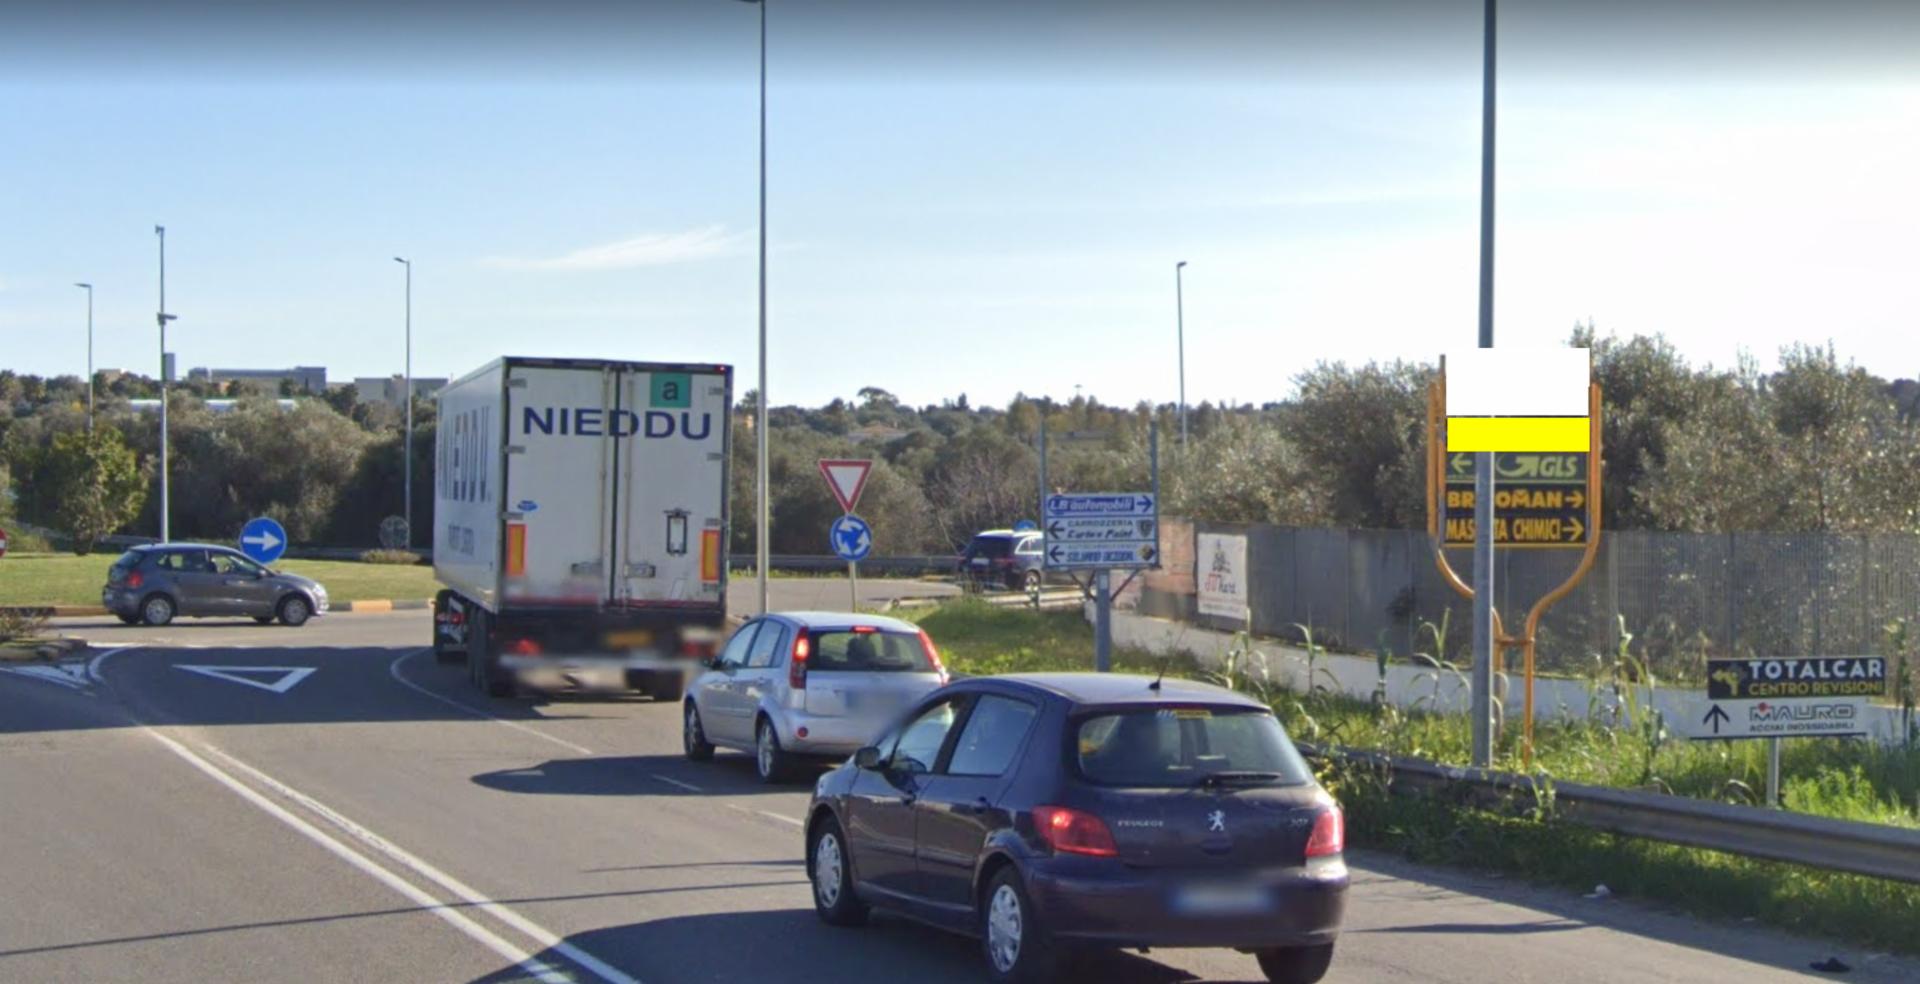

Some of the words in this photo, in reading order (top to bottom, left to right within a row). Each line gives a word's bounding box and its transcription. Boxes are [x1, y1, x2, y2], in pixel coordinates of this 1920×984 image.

[662, 380, 679, 401] a
[523, 407, 711, 440] NIEDDU
[1539, 456, 1578, 478] GLS
[1070, 496, 1133, 512] automobili
[1447, 489, 1562, 508] BROMAN
[1513, 519, 1561, 540] CHIMICI
[1748, 659, 1883, 679] TOTALCAR
[1748, 684, 1809, 696] CENTRO
[1812, 681, 1883, 695] REVISIONI
[1750, 702, 1854, 721] MAURO
